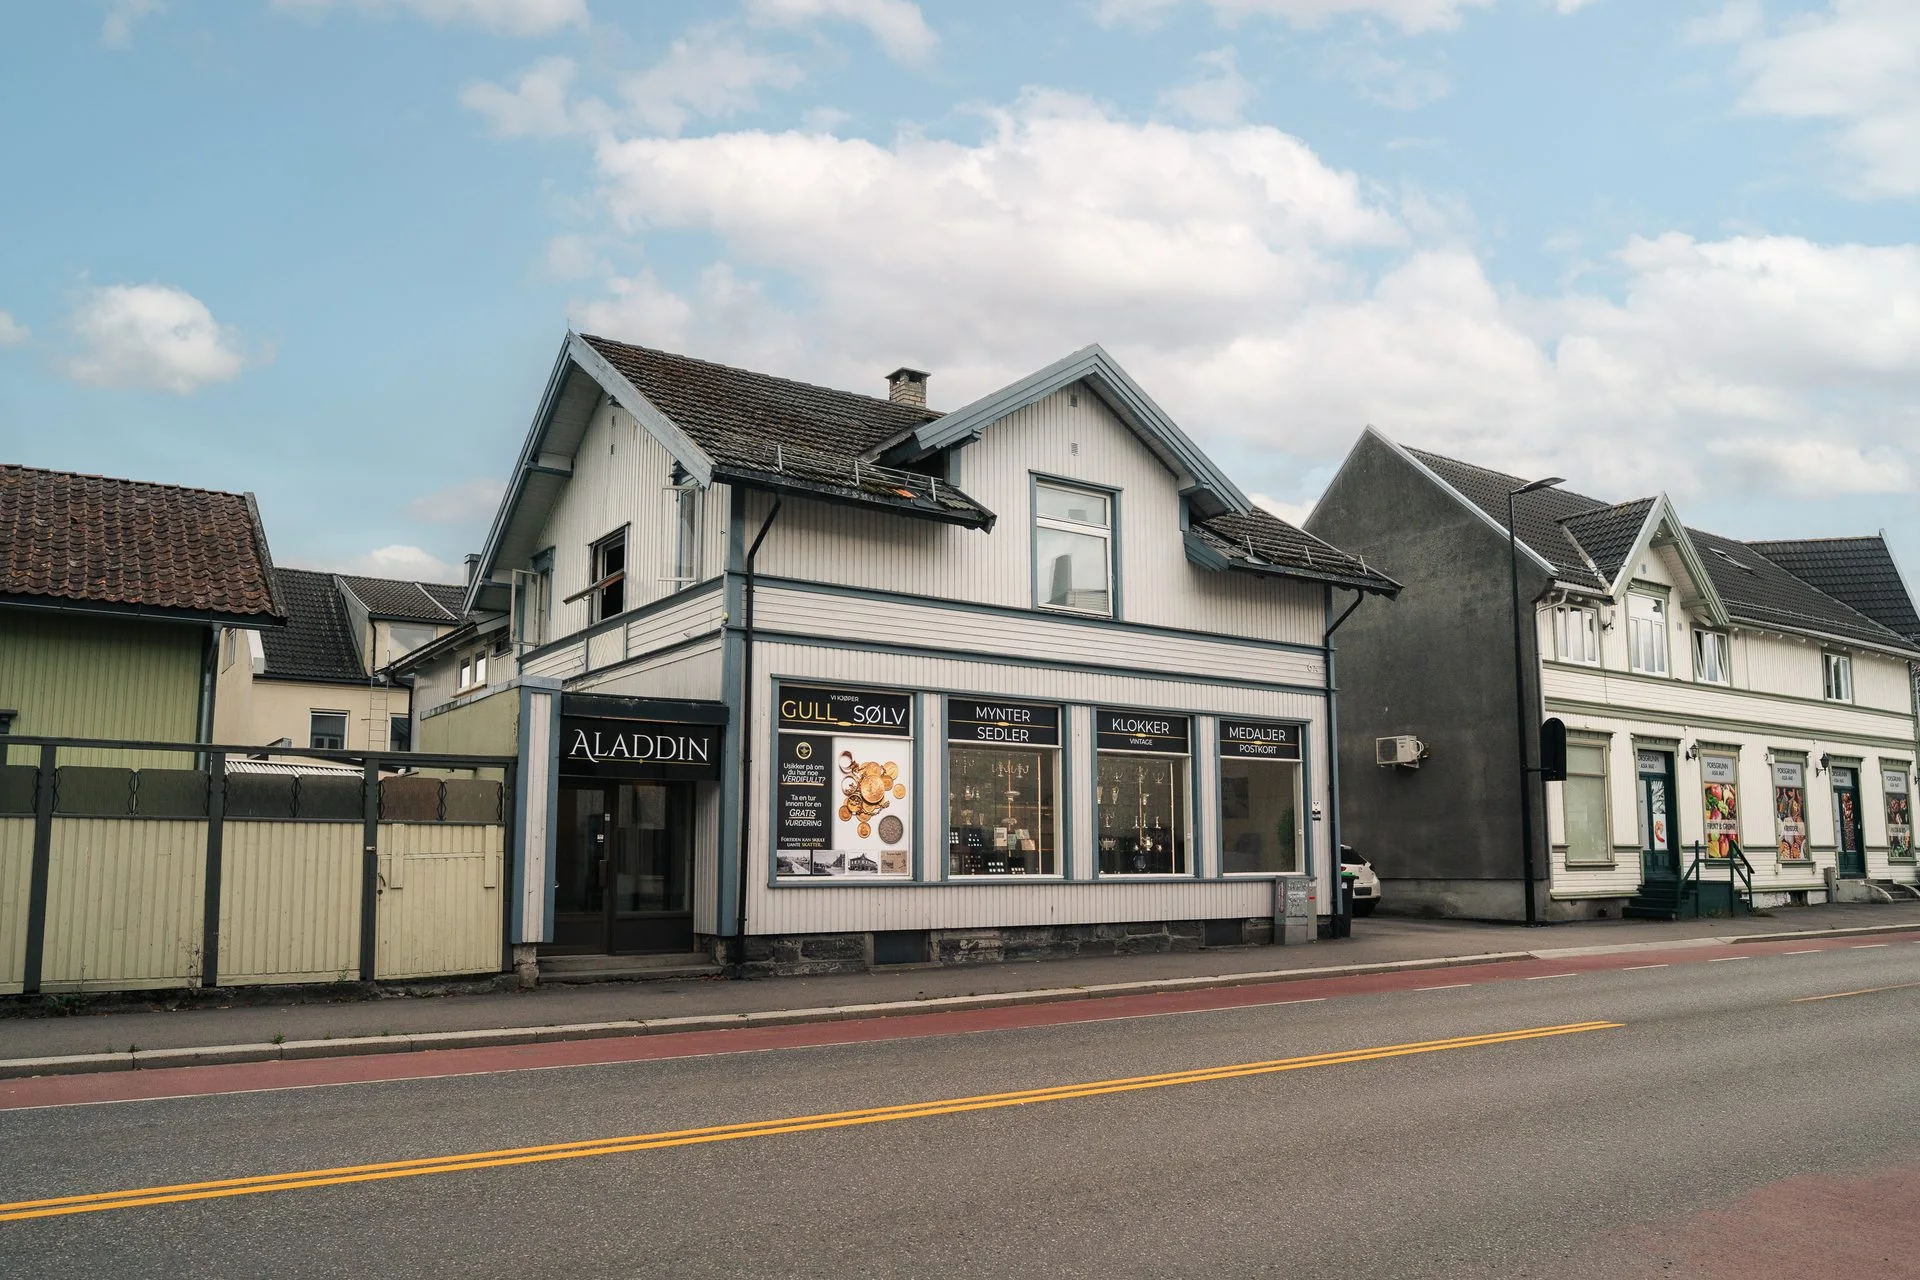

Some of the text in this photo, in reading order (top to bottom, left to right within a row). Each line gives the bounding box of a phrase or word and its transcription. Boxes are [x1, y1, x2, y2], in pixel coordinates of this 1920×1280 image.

[781, 700, 906, 725] GULL SØLV
[976, 706, 1031, 722] MYNTER
[977, 726, 1029, 742] SEDLER
[1112, 718, 1170, 735] KLOKKER
[1229, 726, 1286, 742] MEDALJER
[569, 728, 709, 763] ALADDIN
[1129, 738, 1153, 746] VINTAGE
[1239, 744, 1277, 754] POSTKORT
[789, 808, 817, 817] GRATIS
[785, 819, 822, 827] VURDERING
